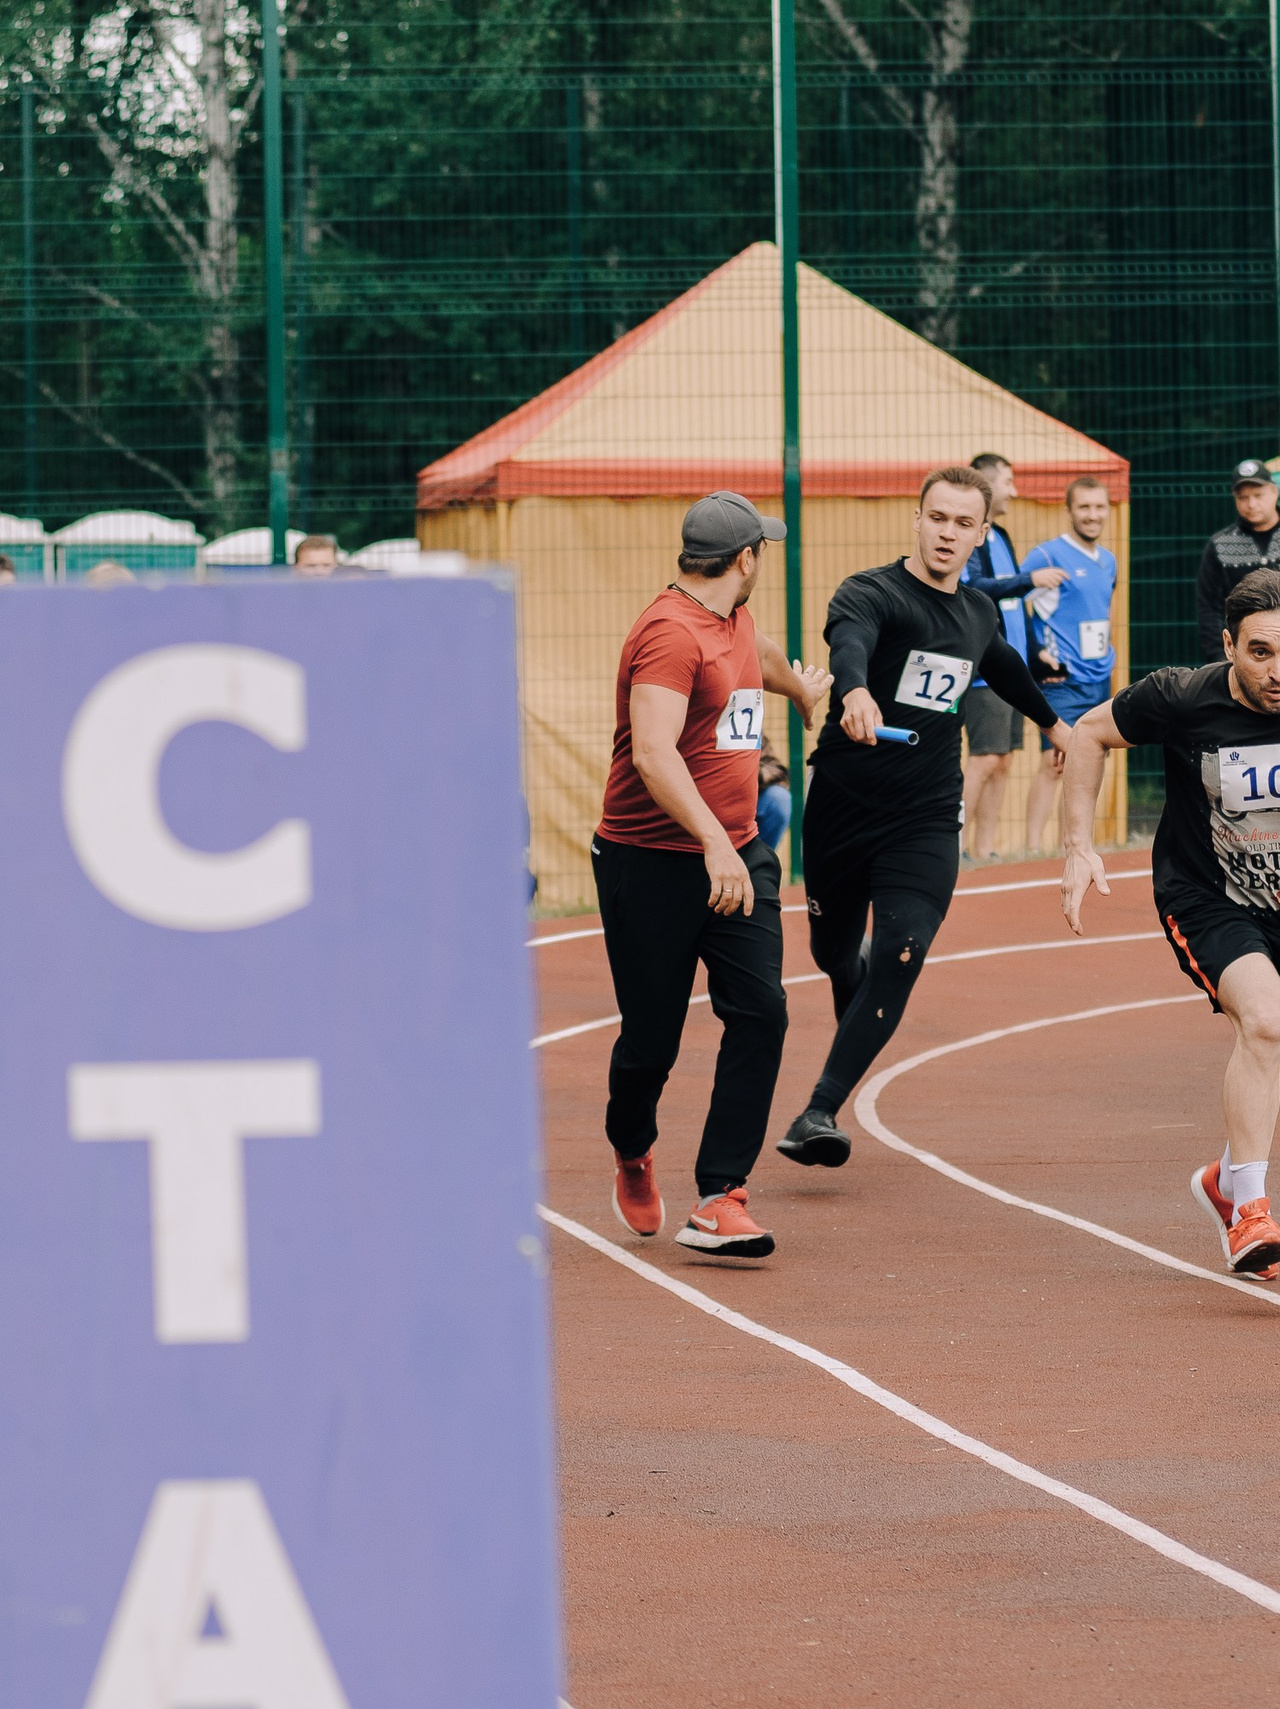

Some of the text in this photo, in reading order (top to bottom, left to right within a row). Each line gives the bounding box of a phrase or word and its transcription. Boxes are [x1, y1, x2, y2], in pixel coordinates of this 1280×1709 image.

[915, 670, 955, 704] 12
[729, 707, 758, 740] 12
[1245, 843, 1266, 853] OLD
